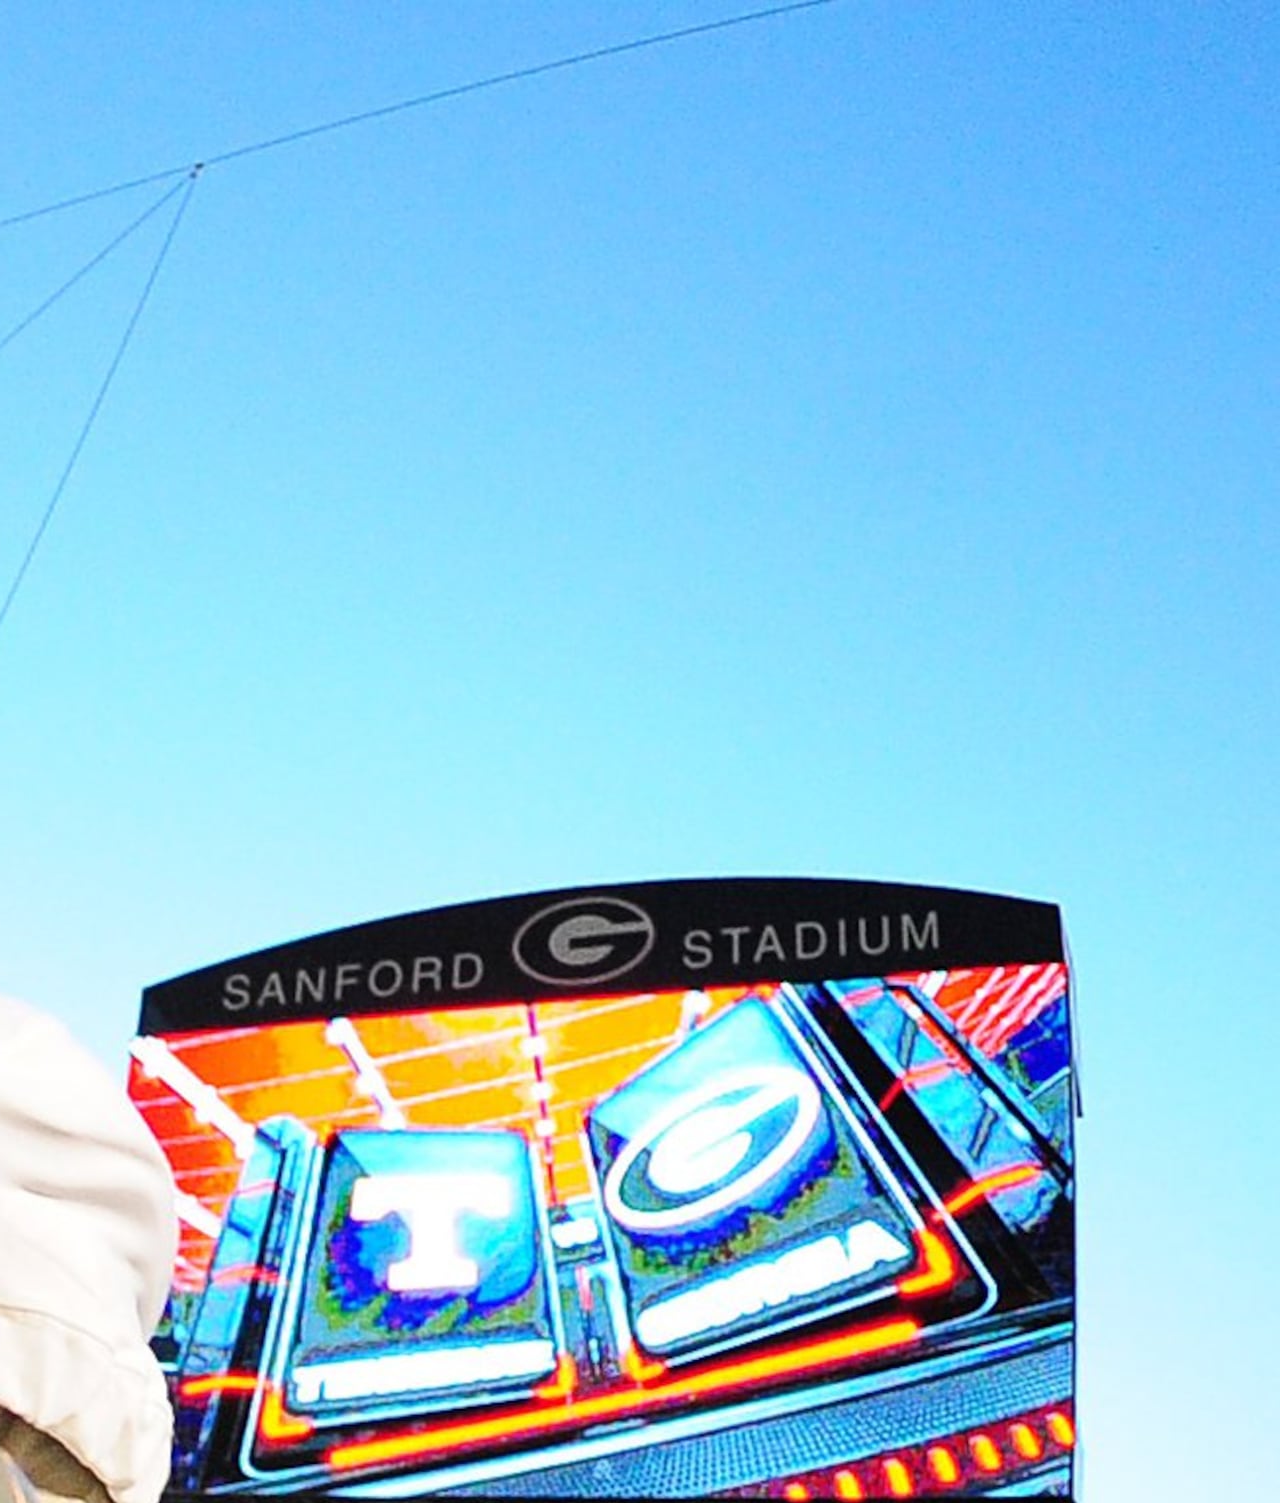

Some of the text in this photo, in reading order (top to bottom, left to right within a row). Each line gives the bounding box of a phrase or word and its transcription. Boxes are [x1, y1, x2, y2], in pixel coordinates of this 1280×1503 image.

[222, 952, 485, 1011] SANFORD
[682, 911, 940, 969] STADIUM
[349, 1173, 513, 1292] T
